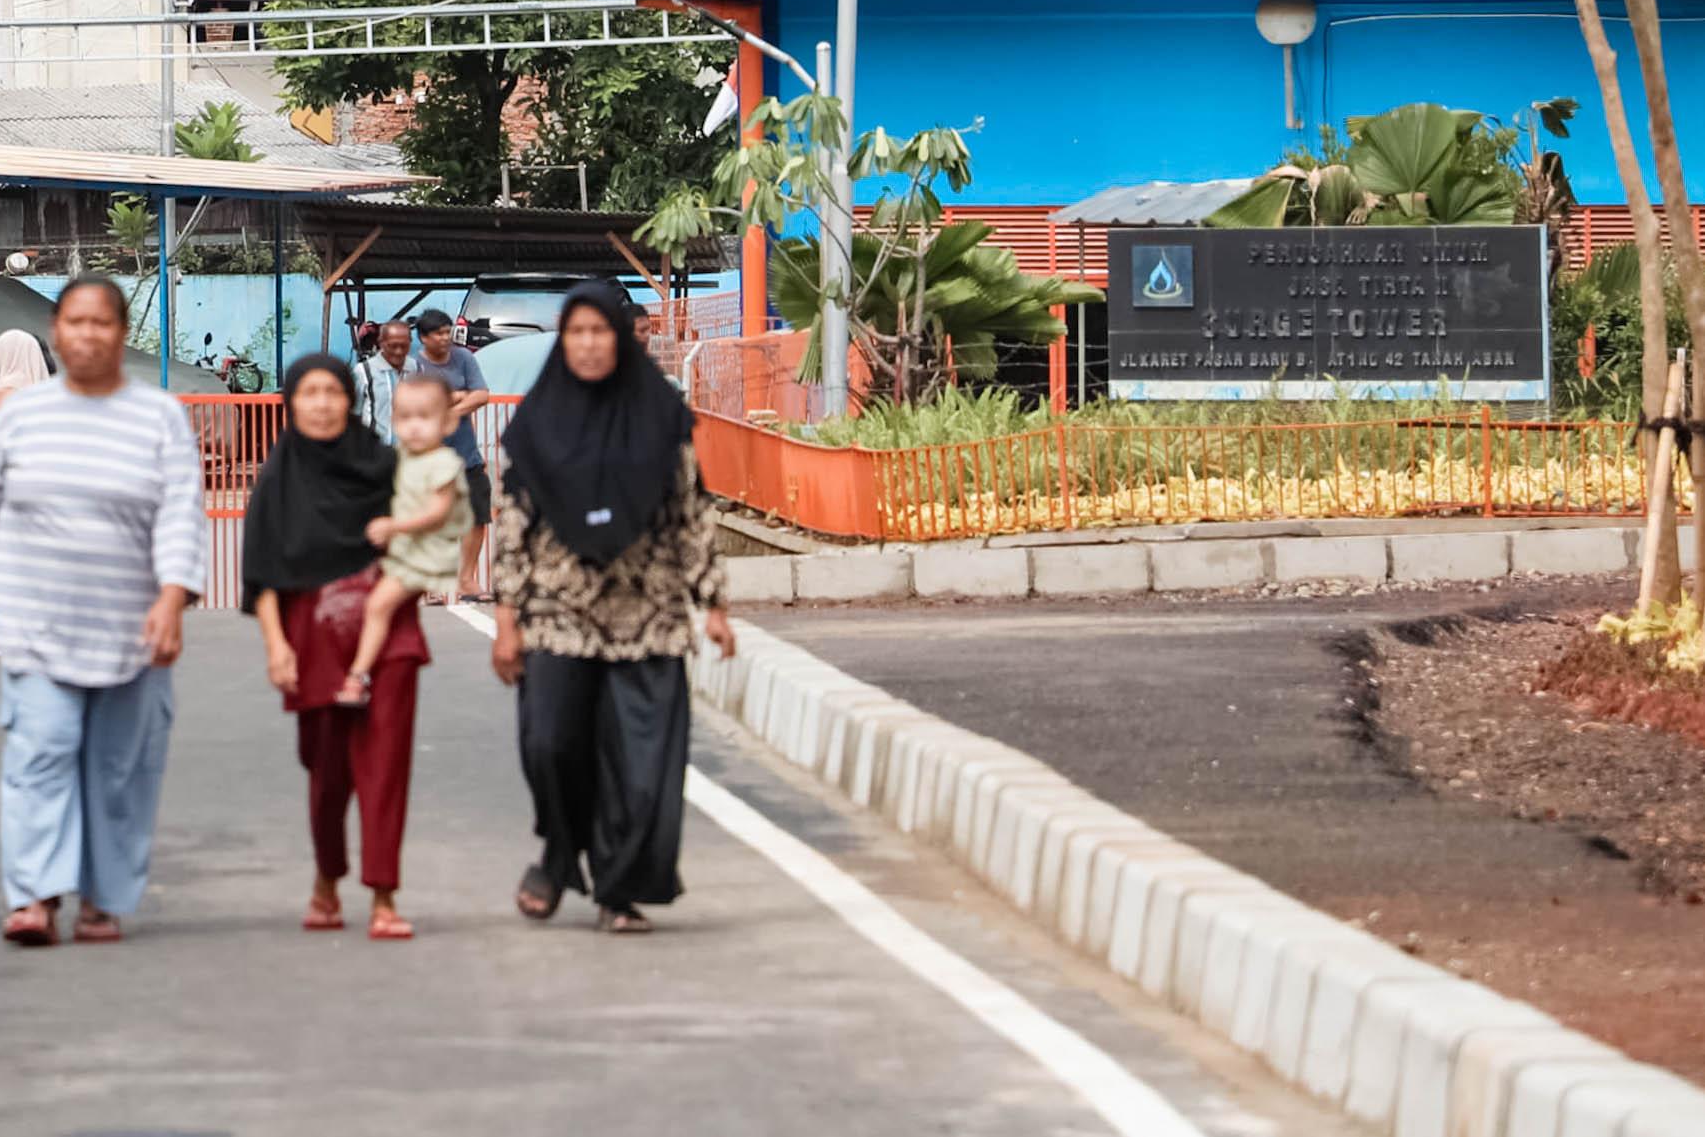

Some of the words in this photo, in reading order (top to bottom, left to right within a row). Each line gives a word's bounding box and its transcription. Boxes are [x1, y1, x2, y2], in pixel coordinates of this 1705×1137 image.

[1418, 241, 1487, 263] UMUM
[1288, 275, 1347, 296] JASA
[1358, 275, 1425, 296] TIRTA
[1200, 308, 1313, 337] SURGE
[1326, 308, 1447, 337] TOWER
[1139, 352, 1188, 367] KARET
[1195, 352, 1243, 367] PASAR
[1249, 352, 1290, 367] BARU
[1385, 352, 1403, 367] 42
